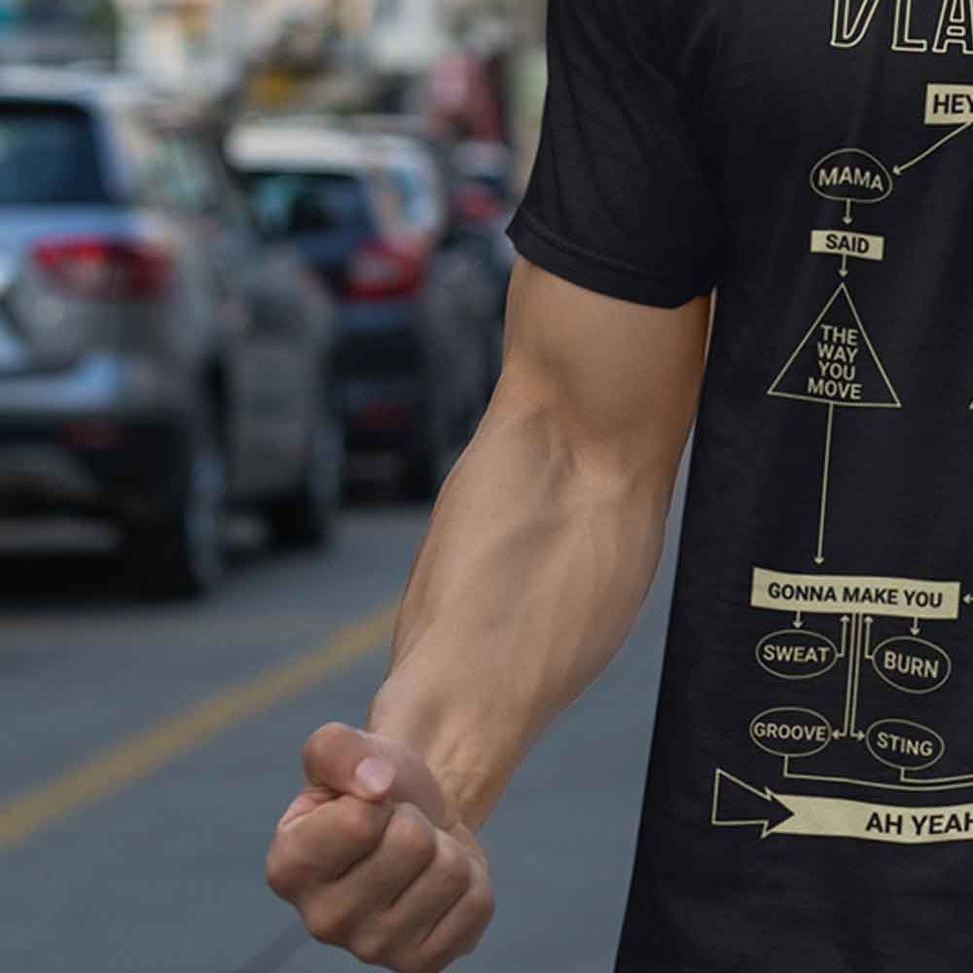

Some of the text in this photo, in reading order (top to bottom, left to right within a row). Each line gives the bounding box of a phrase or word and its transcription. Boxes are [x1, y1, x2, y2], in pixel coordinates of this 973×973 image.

[818, 166, 884, 192] MAMA
[825, 233, 869, 254] SAID
[821, 325, 858, 346] THE
[817, 343, 858, 363] WAY
[818, 361, 856, 380] YOU
[808, 378, 862, 400] MOVE
[767, 582, 943, 608] GONNA MAKE YOU
[763, 645, 829, 664] SWEAT
[884, 652, 939, 678] BURN
[753, 722, 827, 741] GROOVE
[877, 732, 933, 757] STING
[866, 813, 900, 834] AH
